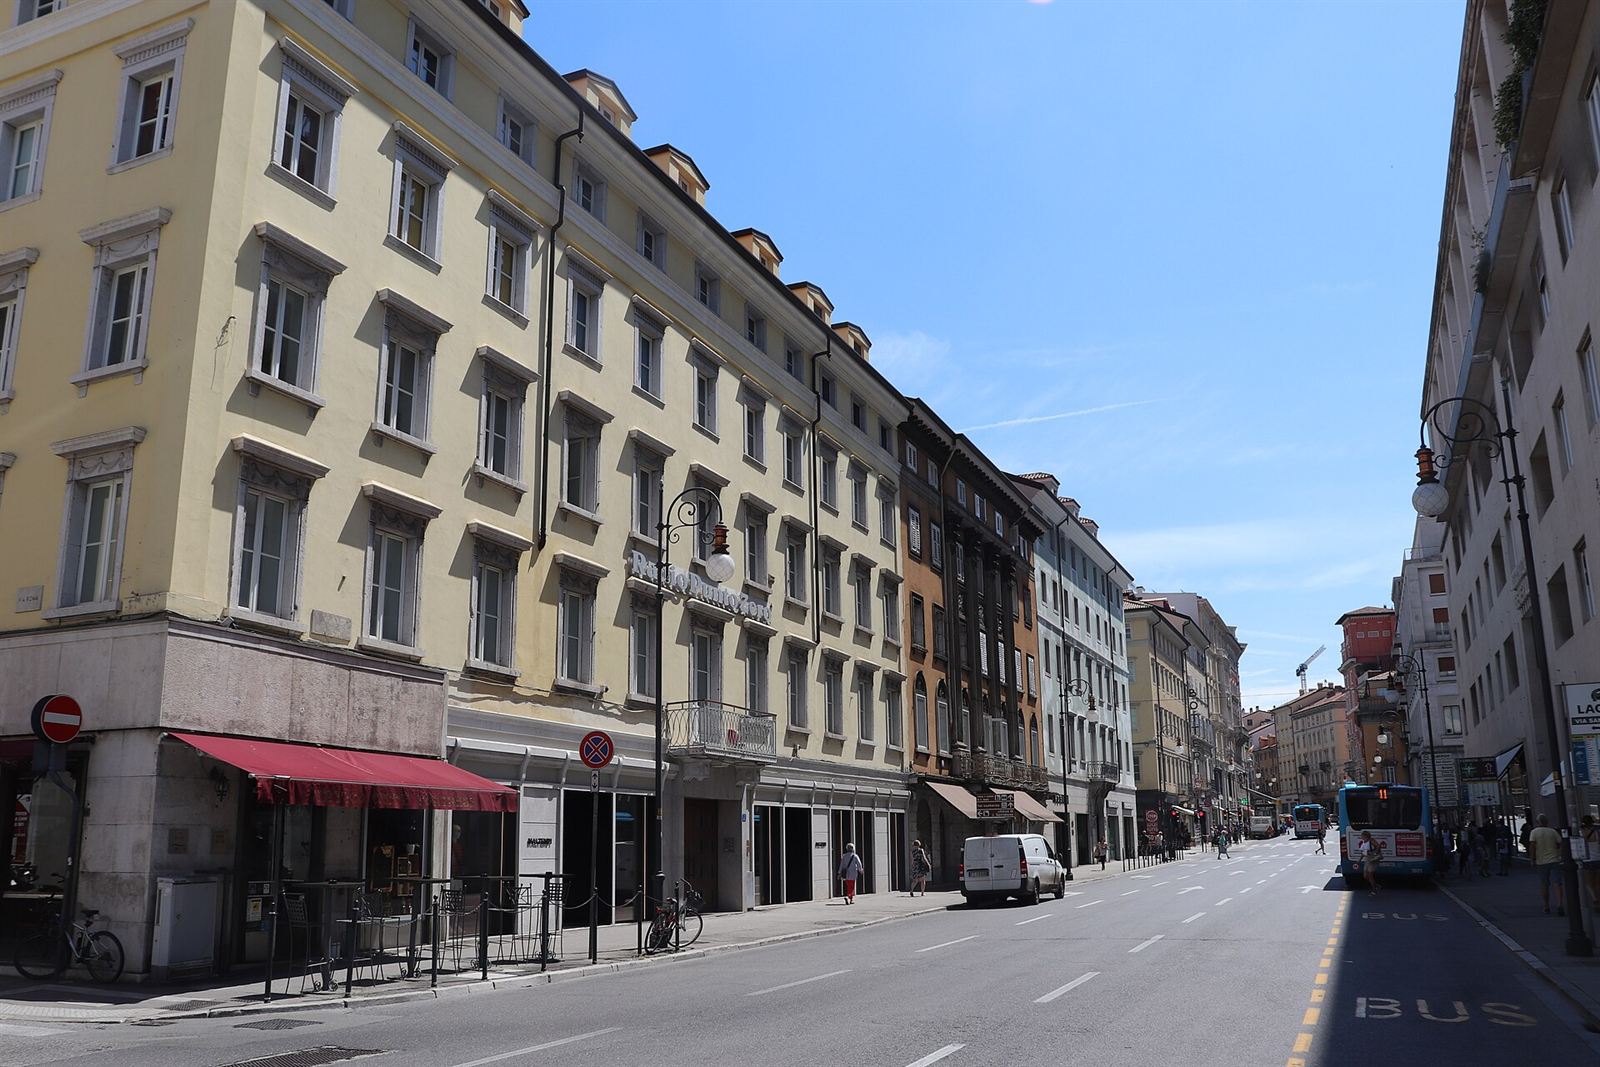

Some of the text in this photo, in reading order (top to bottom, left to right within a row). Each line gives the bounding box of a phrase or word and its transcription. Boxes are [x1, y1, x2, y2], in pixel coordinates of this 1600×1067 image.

[690, 572, 738, 608] Punto
[739, 592, 770, 621] Zero
[1379, 788, 1388, 800] 11
[1361, 912, 1448, 922] BUS
[1355, 997, 1537, 1027] BUS
